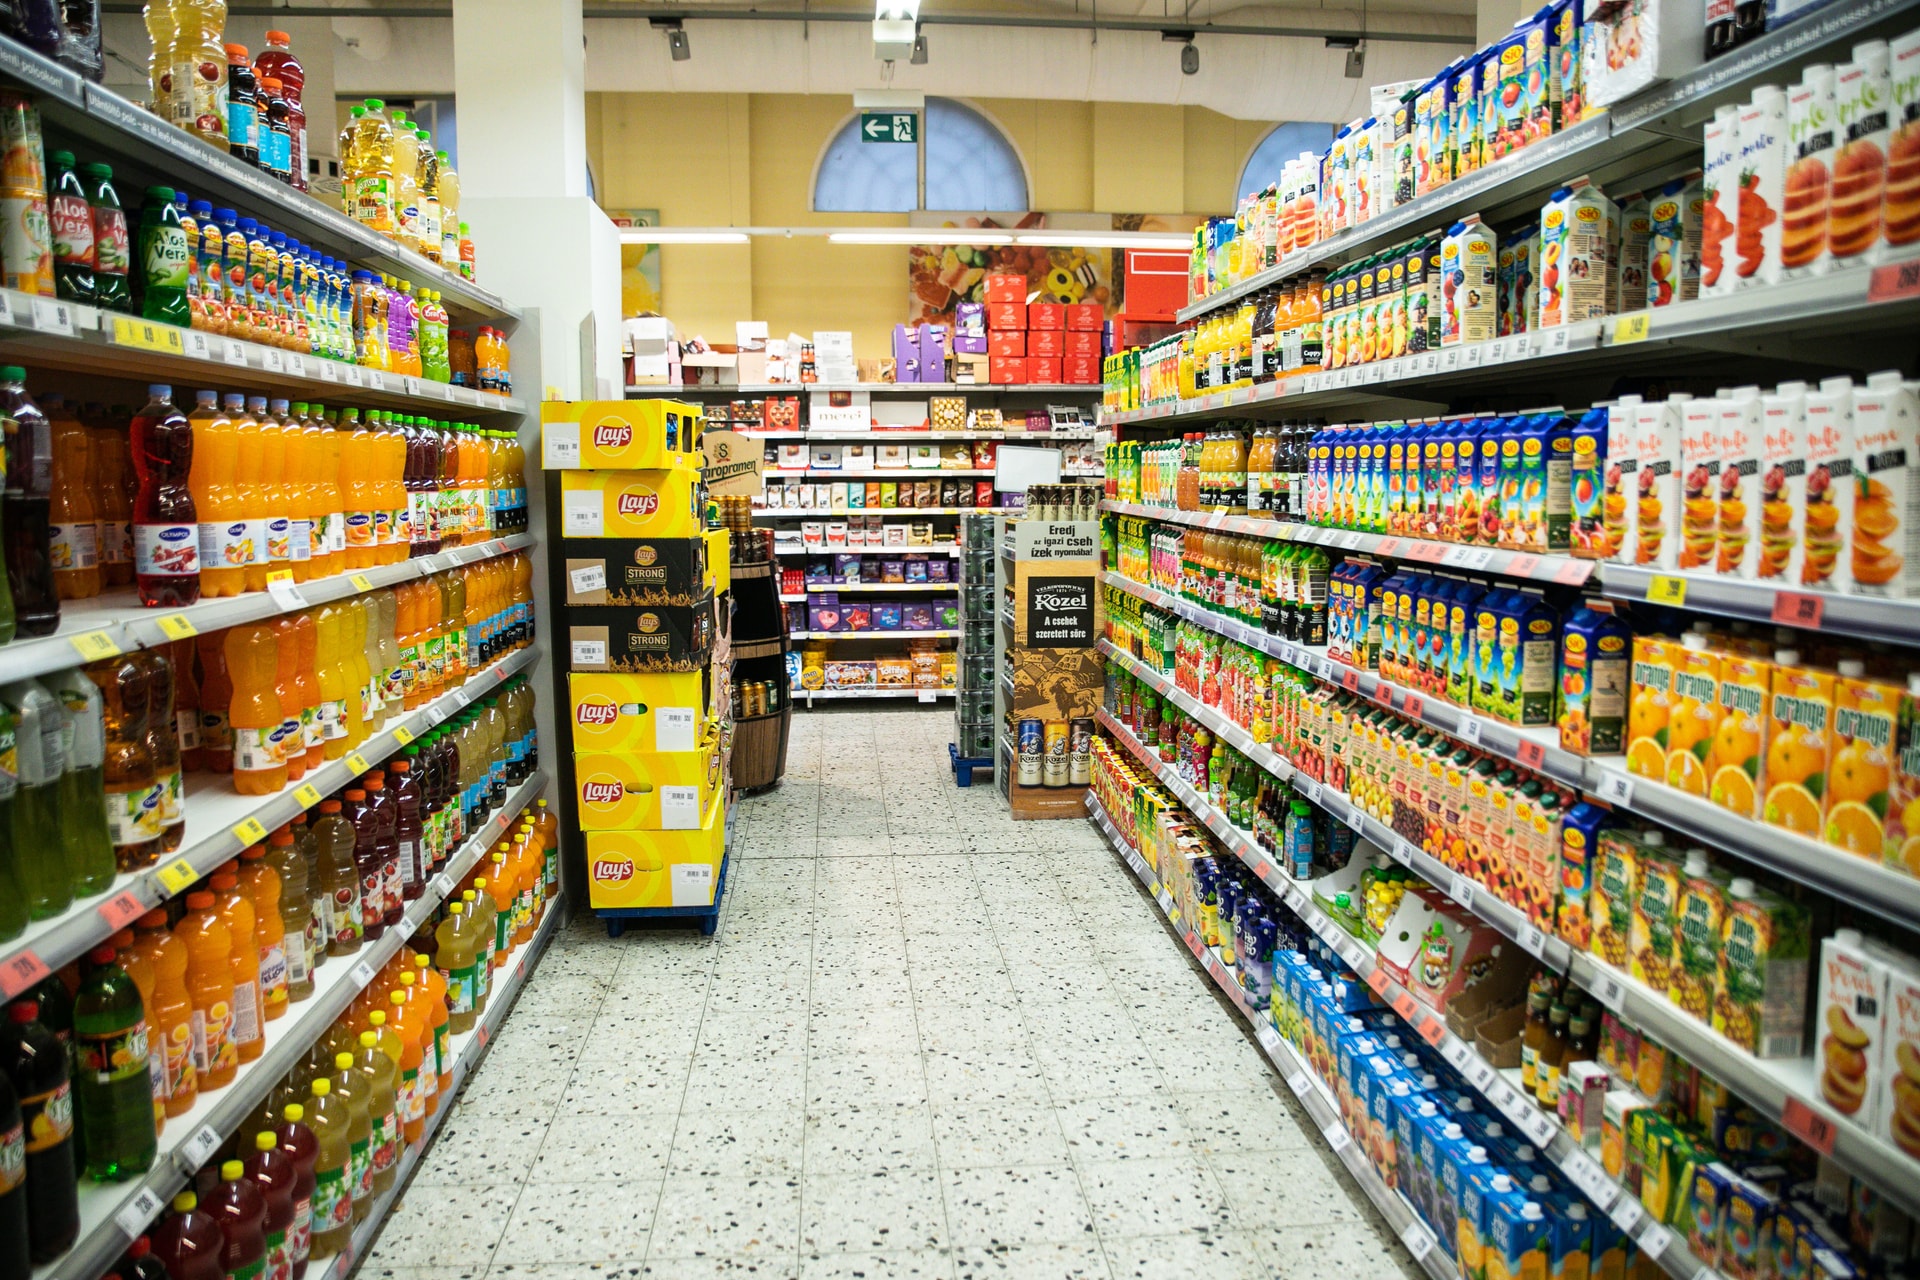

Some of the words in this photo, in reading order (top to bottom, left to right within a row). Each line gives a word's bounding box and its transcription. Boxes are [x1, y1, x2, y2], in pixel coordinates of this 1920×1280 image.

[52, 198, 88, 220] Aloe
[53, 216, 90, 235] Vera
[155, 244, 187, 261] Vera
[1303, 350, 1321, 358] Cappy
[819, 410, 862, 420] merci
[596, 425, 630, 449] Lay's
[621, 494, 656, 516] Lay's
[1049, 525, 1076, 537] Eredj
[1044, 537, 1064, 546] igazi
[1066, 536, 1093, 546] cseh
[1031, 548, 1052, 558] ízek
[1054, 548, 1093, 558] nyomába!
[628, 569, 664, 578] STRONG
[1034, 594, 1088, 612] Kozel
[1044, 616, 1050, 626] A
[1052, 615, 1078, 626] csehek
[631, 635, 667, 645] STRONG
[1035, 630, 1068, 639] szeretett
[1070, 629, 1087, 639] söre
[1634, 661, 1670, 691] orange
[1675, 672, 1715, 703] orange
[1720, 681, 1761, 716] orange
[580, 702, 615, 725] Lay's
[1773, 694, 1827, 732] orange
[1835, 706, 1890, 747] orange
[1020, 755, 1042, 764] Kozel
[1045, 755, 1068, 765] Kozel
[1071, 754, 1090, 764] Koze
[586, 781, 621, 803] Lay's
[596, 859, 632, 882] Lay's
